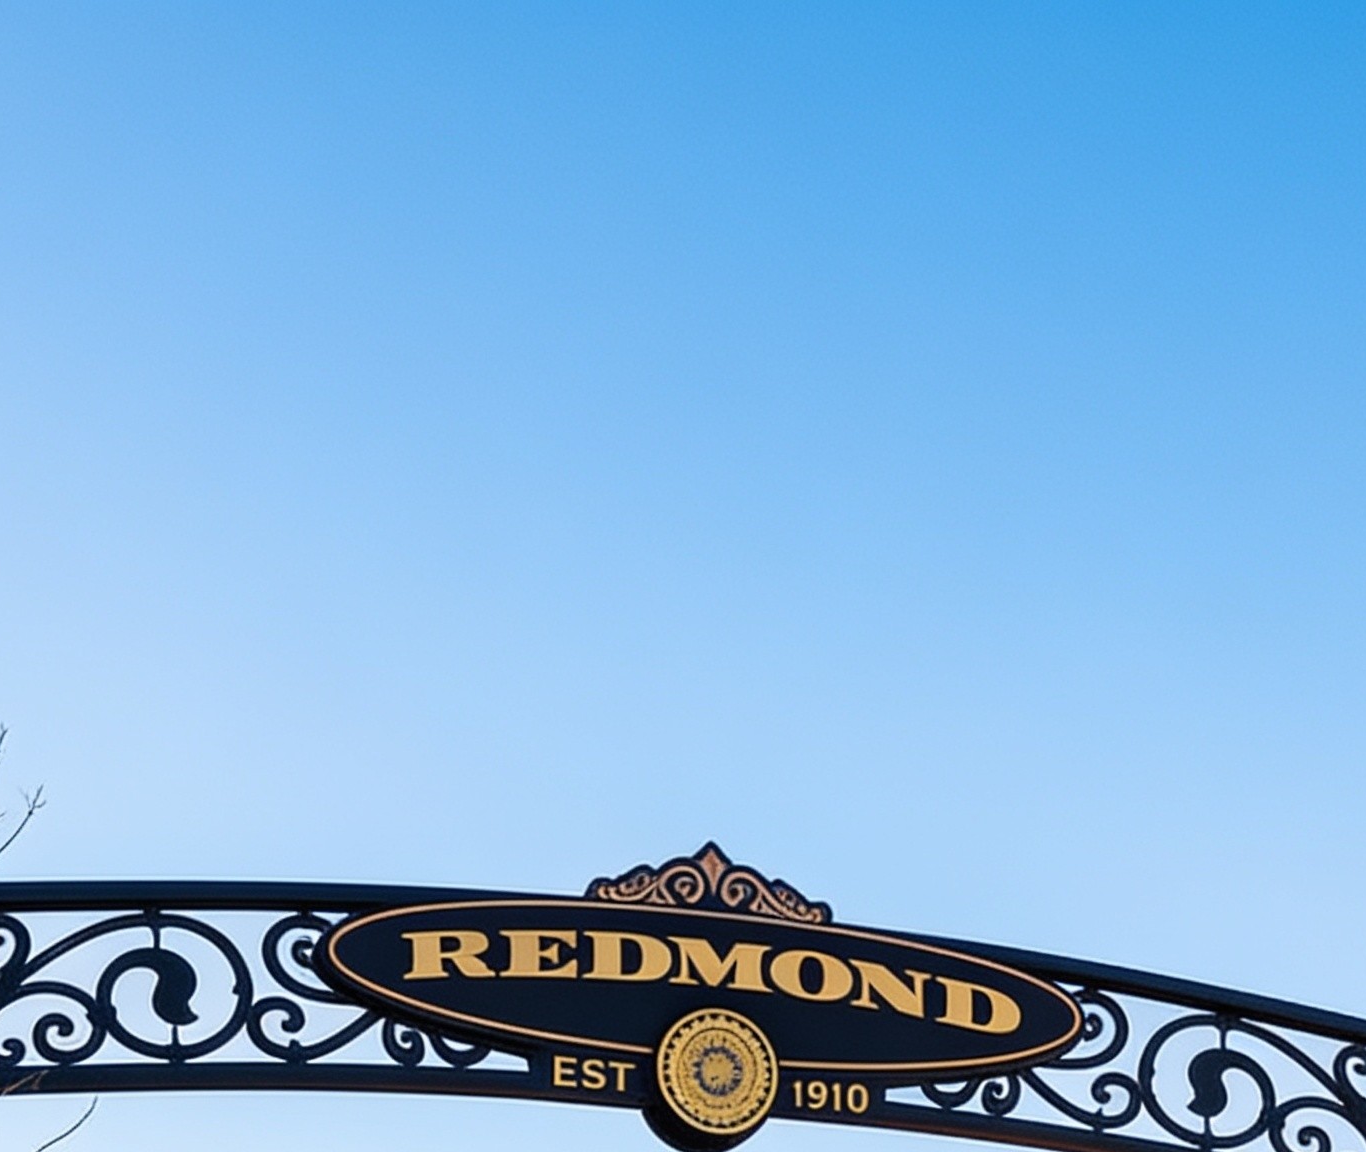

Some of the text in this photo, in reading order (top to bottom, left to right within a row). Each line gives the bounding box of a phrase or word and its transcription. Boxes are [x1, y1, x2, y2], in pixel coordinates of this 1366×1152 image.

[402, 930, 1022, 1034] REDMOND
[553, 1055, 869, 1114] EST 1910
